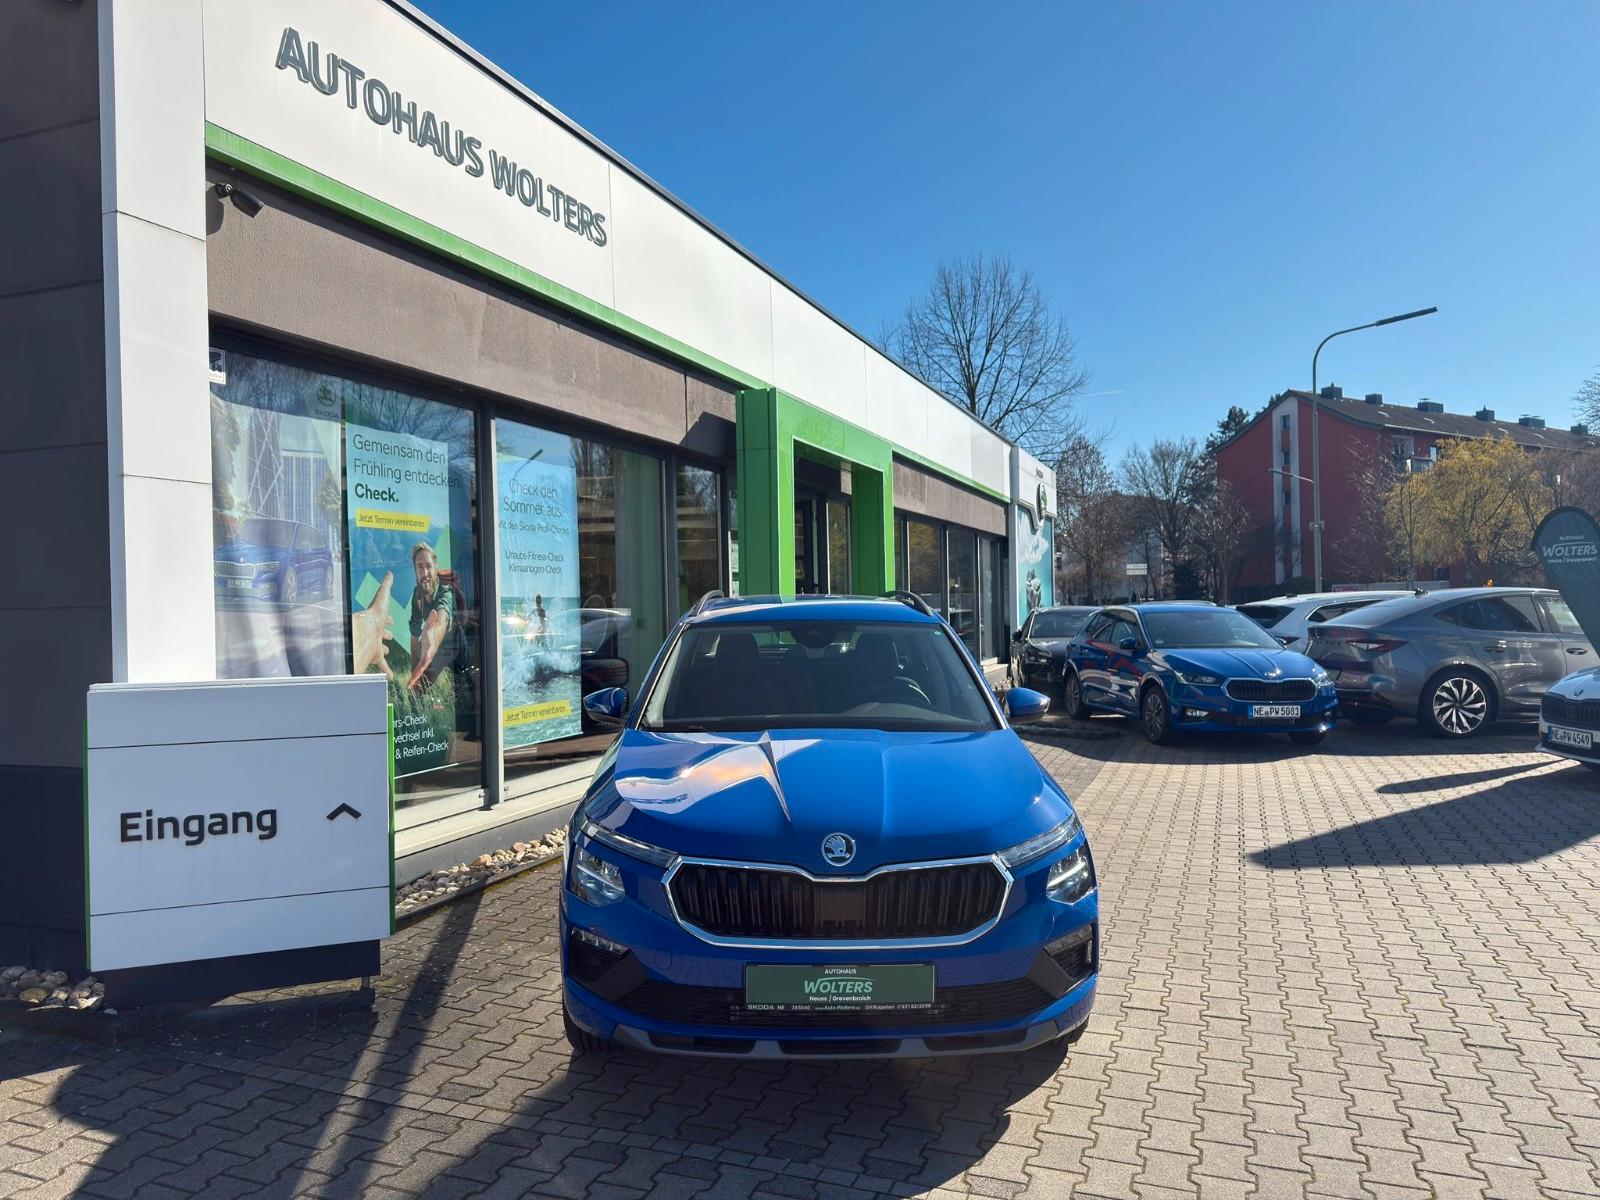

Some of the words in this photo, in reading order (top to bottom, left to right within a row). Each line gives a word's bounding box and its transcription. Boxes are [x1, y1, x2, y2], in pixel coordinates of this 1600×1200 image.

[275, 26, 484, 178] AUTOHAUS
[488, 149, 608, 248] WOLTERS
[352, 433, 423, 460] Gemeinsam
[425, 446, 446, 465] den
[353, 457, 402, 484] Frühling
[354, 483, 400, 503] Check.
[509, 478, 539, 497] Check
[540, 484, 557, 500] den
[503, 496, 544, 516] Sommer
[1542, 545, 1598, 557] WOLTERS
[1253, 706, 1264, 716] NE
[1269, 706, 1280, 716] PW
[1280, 706, 1299, 716] 5081
[395, 748, 402, 759] &
[403, 740, 449, 758] Reifen-Check
[120, 809, 278, 847] Eingang
[803, 978, 874, 994] WOLTERS
